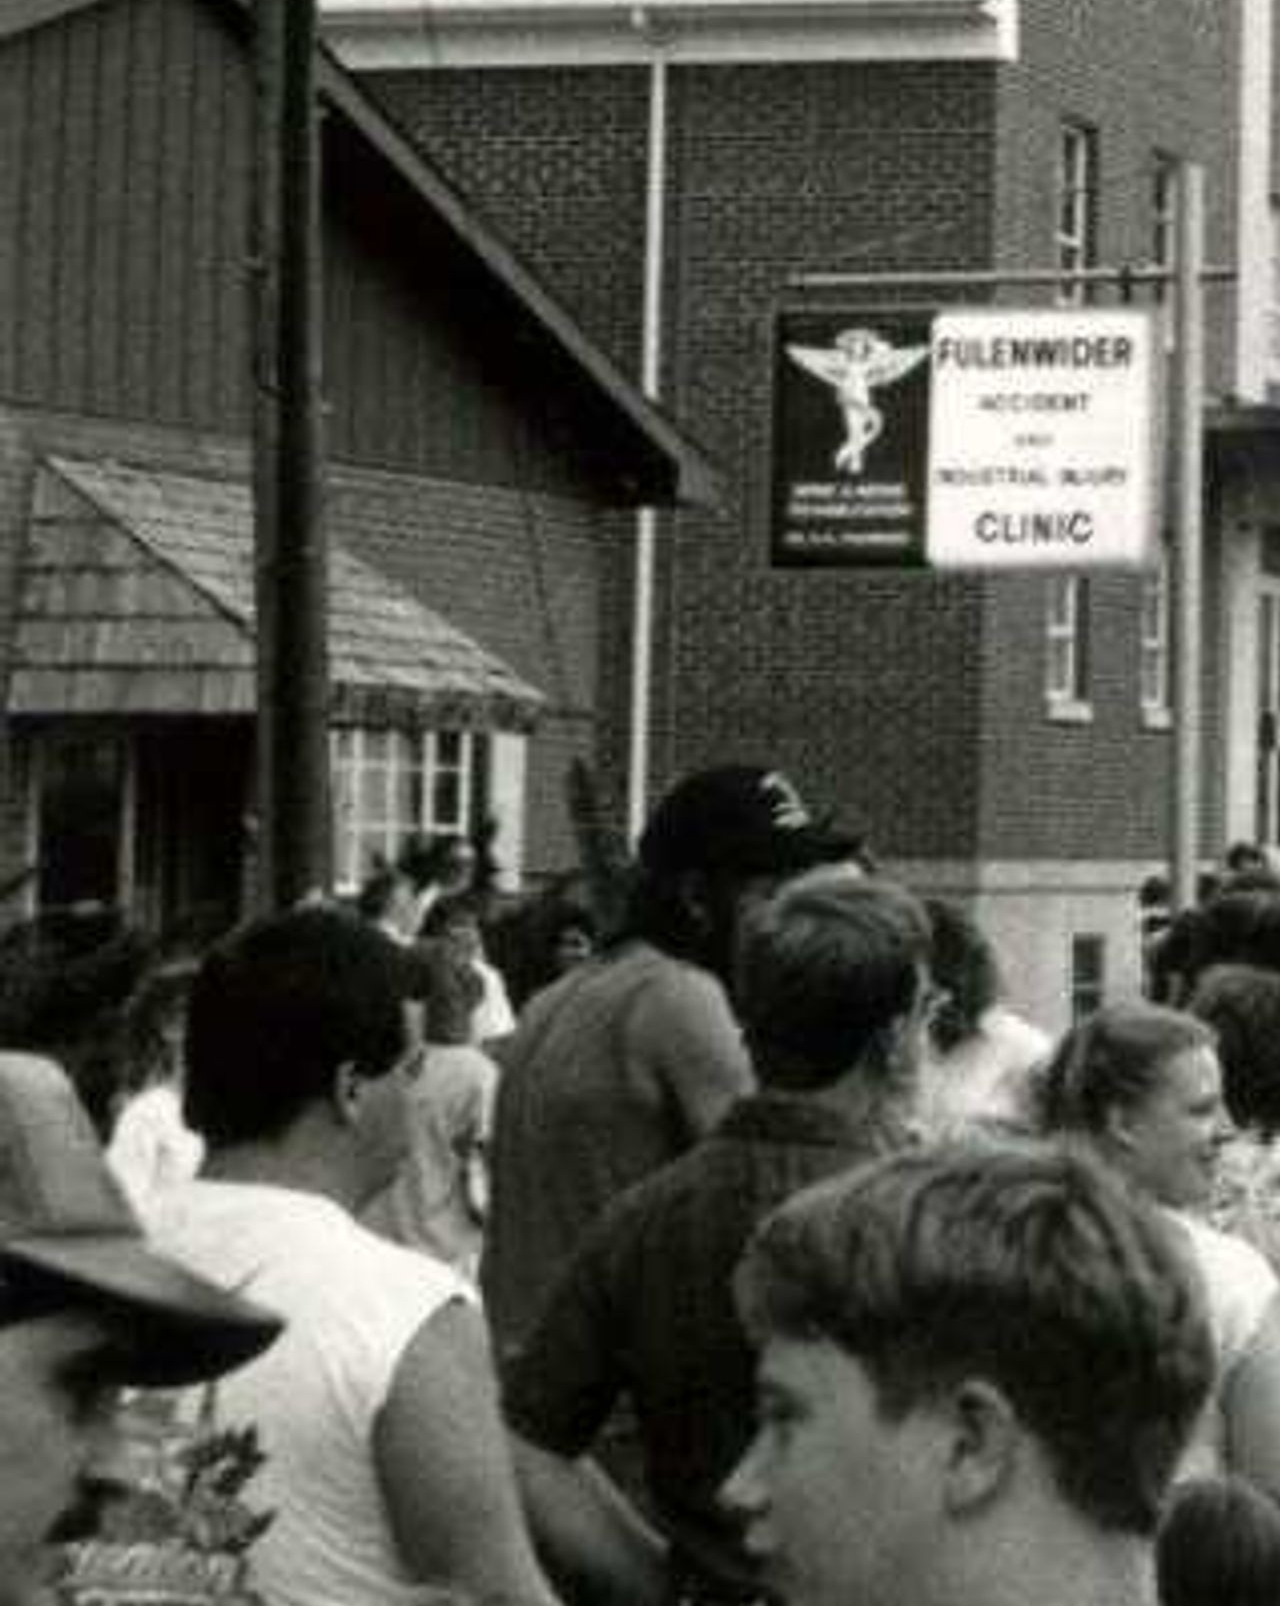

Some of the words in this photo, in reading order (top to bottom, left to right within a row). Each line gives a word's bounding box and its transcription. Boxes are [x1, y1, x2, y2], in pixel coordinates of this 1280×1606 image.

[938, 336, 1133, 369] FULENWIDER
[978, 392, 1092, 412] ACCIDENT
[976, 510, 1094, 544] CLINIC
